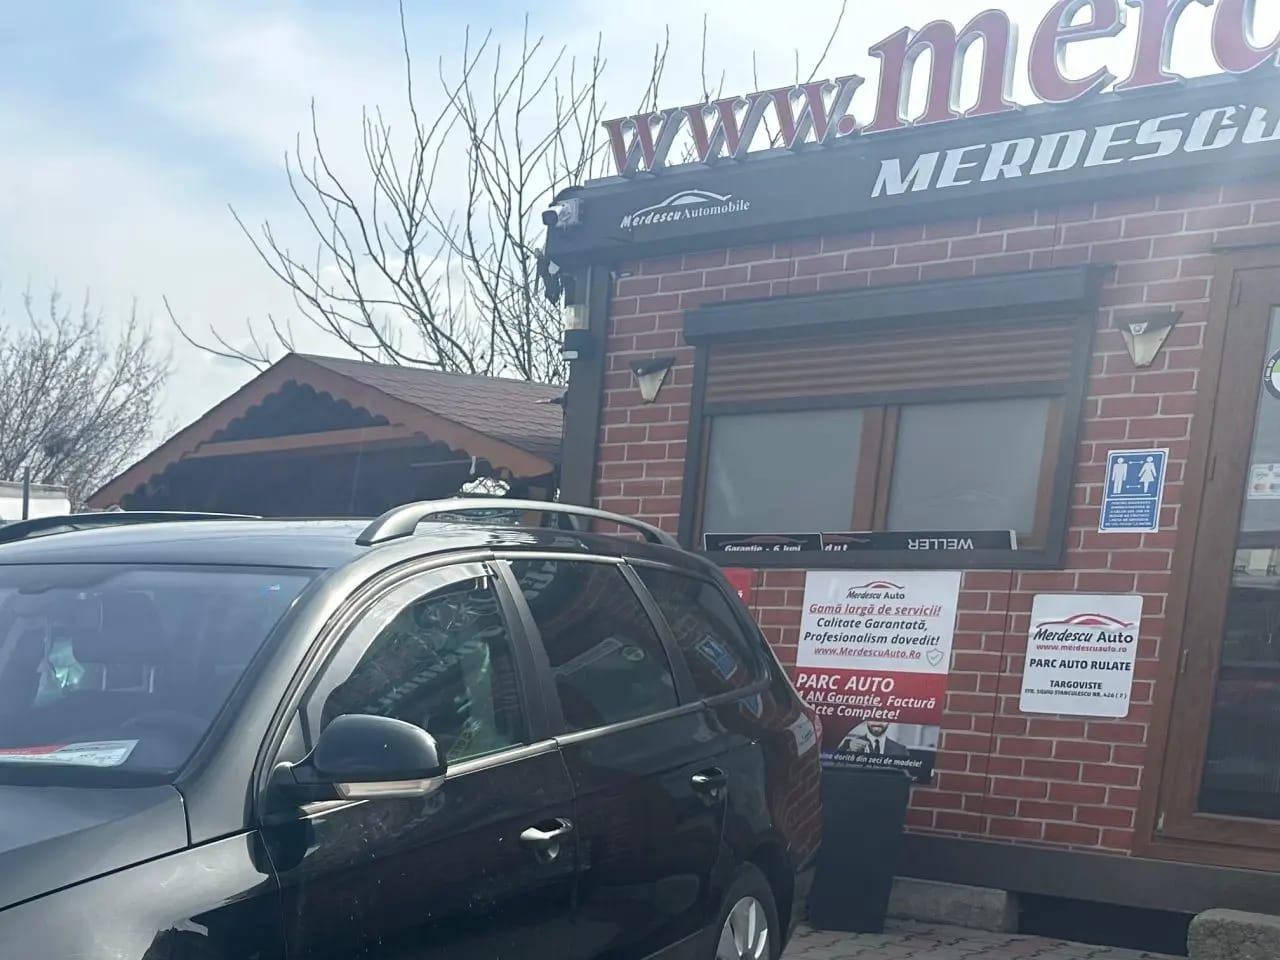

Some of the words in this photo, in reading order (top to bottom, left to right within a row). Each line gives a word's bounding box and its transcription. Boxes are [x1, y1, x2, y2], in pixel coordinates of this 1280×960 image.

[620, 211, 682, 229] Merdescu
[682, 199, 751, 220] Automobile
[908, 538, 974, 550] WELLER
[847, 590, 882, 600] Merdescu
[883, 591, 905, 600] Auto
[877, 605, 891, 615] de
[894, 606, 942, 617] servicii!
[816, 617, 861, 628] Calitate
[864, 618, 928, 631] Garantată,
[803, 631, 888, 645] Profesionalism
[891, 633, 941, 646] dovedit!
[1033, 628, 1094, 643] Merdescu
[1096, 631, 1134, 644] Auto
[814, 646, 921, 660] www.MerdescuAuto.Ro
[1036, 644, 1128, 653] www.merdescuauto.ro
[1029, 658, 1057, 669] PARC
[1058, 659, 1088, 670] AUTO
[1090, 661, 1132, 671] RULATE
[796, 673, 841, 690] PARC
[843, 675, 895, 692] AUTO
[1050, 680, 1103, 690] TARGOVISTE
[806, 690, 825, 702] AN
[836, 705, 901, 721] Complete!
